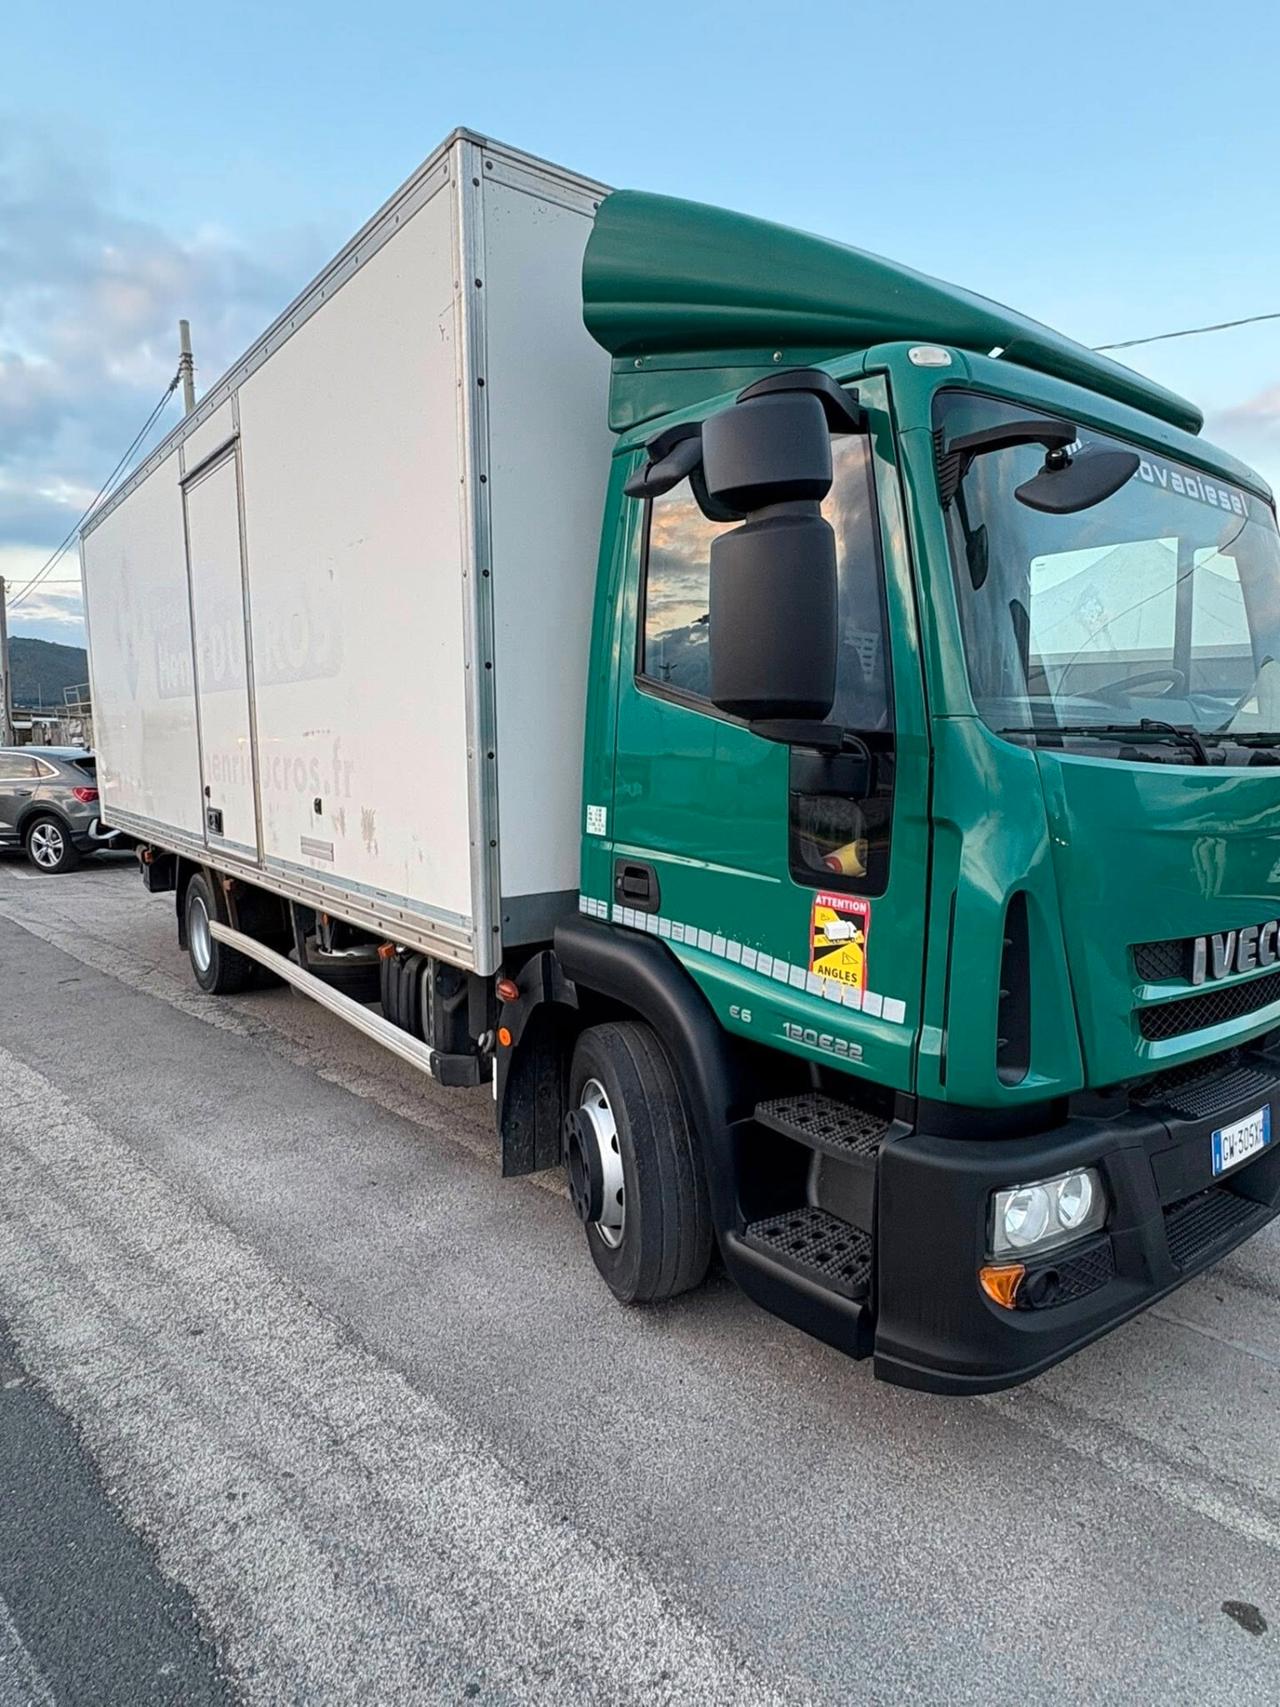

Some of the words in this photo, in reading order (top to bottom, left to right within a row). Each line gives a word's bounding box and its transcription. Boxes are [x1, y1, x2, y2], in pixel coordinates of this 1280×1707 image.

[815, 895, 867, 913] ATTENTION
[1193, 920, 1280, 985] IVEC
[818, 965, 858, 983] ANGLES
[729, 1005, 752, 1023] E6
[782, 1022, 864, 1061] 120E22
